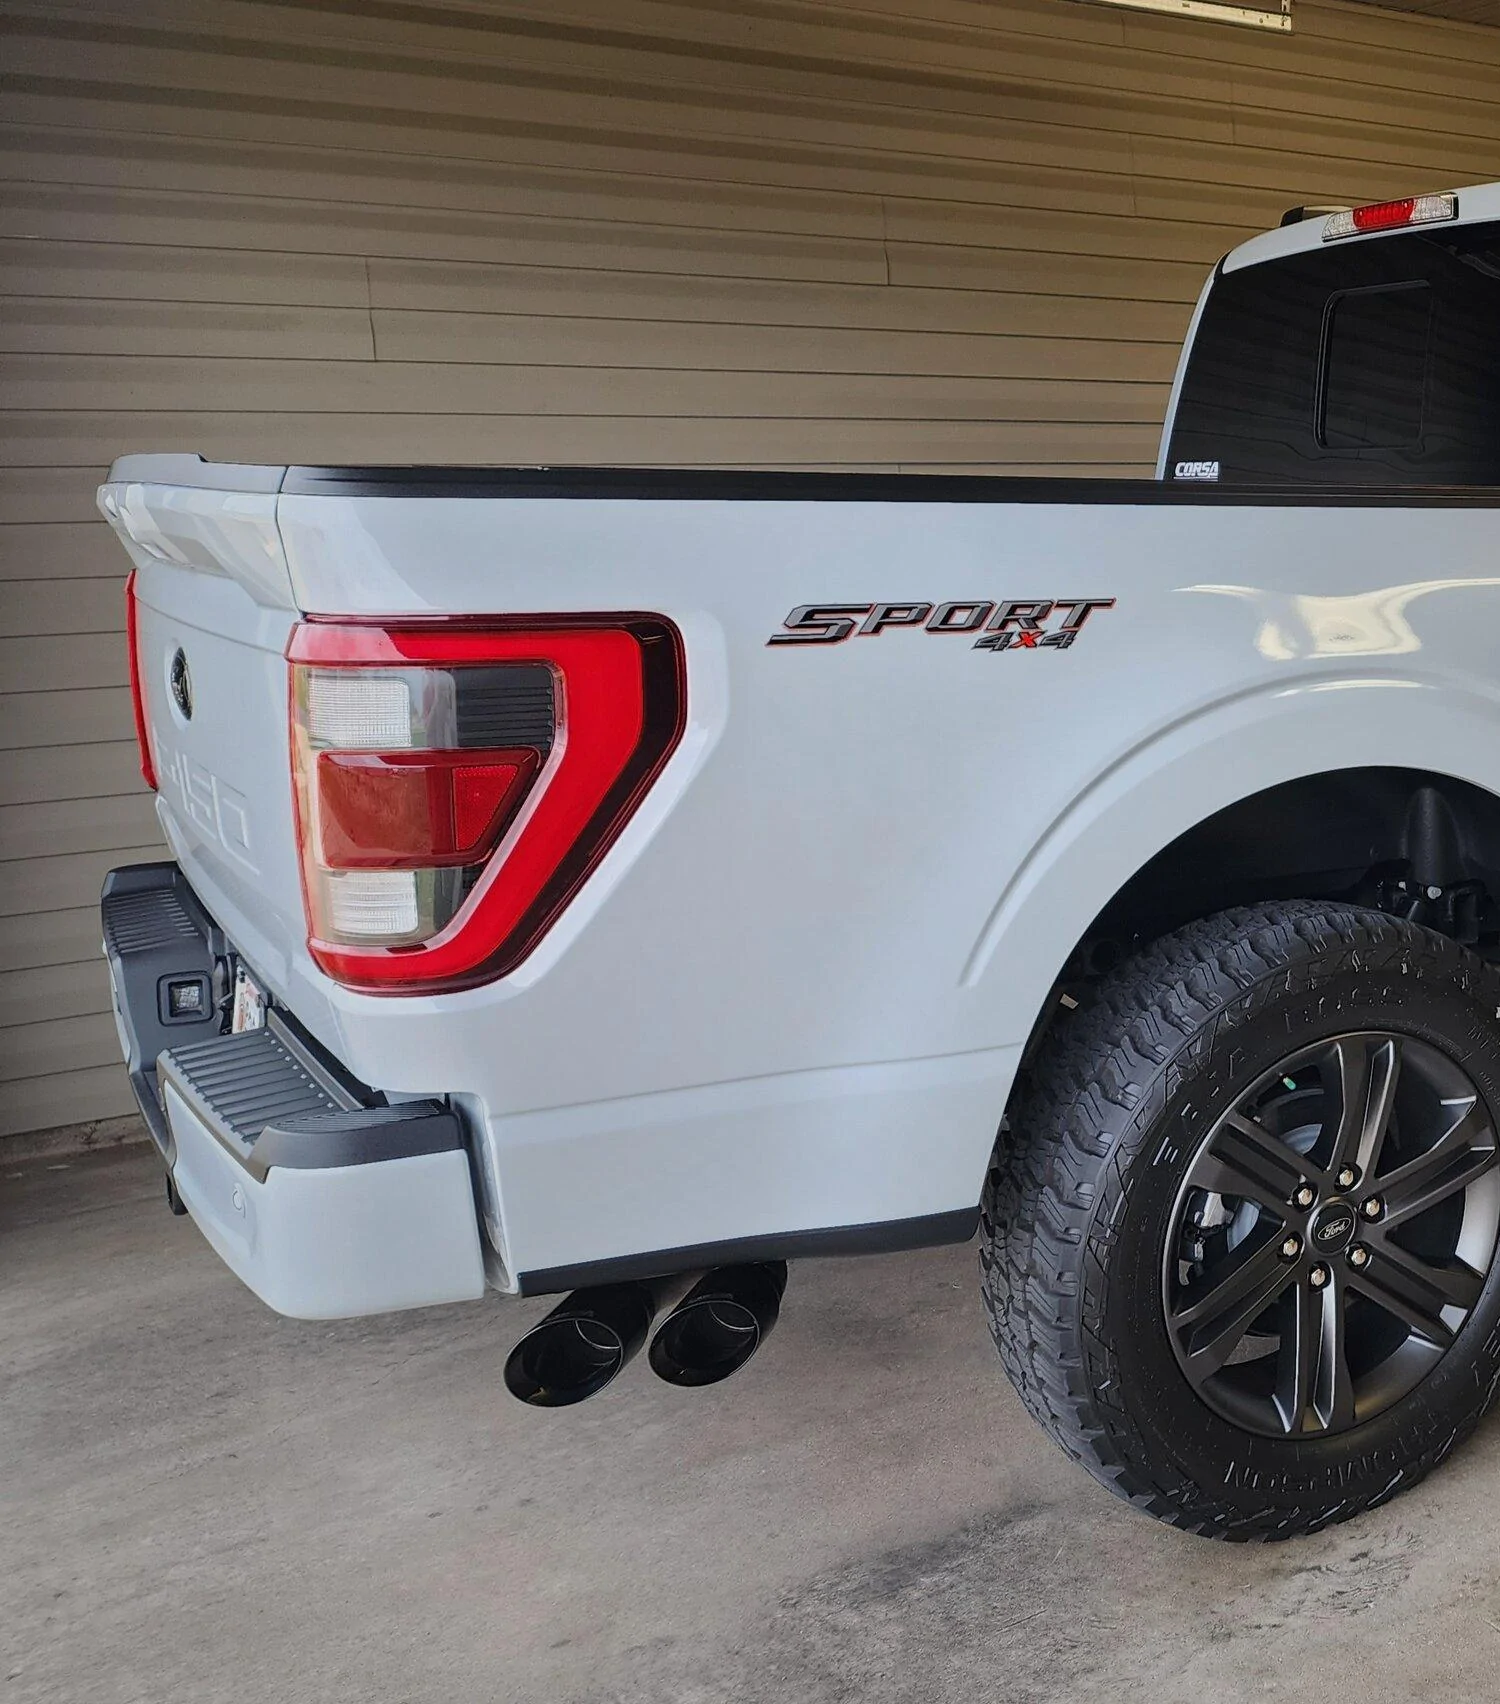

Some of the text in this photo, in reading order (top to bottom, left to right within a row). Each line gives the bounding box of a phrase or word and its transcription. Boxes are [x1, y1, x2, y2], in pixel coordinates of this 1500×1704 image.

[1174, 461, 1219, 477] CORSA
[764, 597, 1116, 647] SPORT
[1321, 1220, 1348, 1239] Ford
